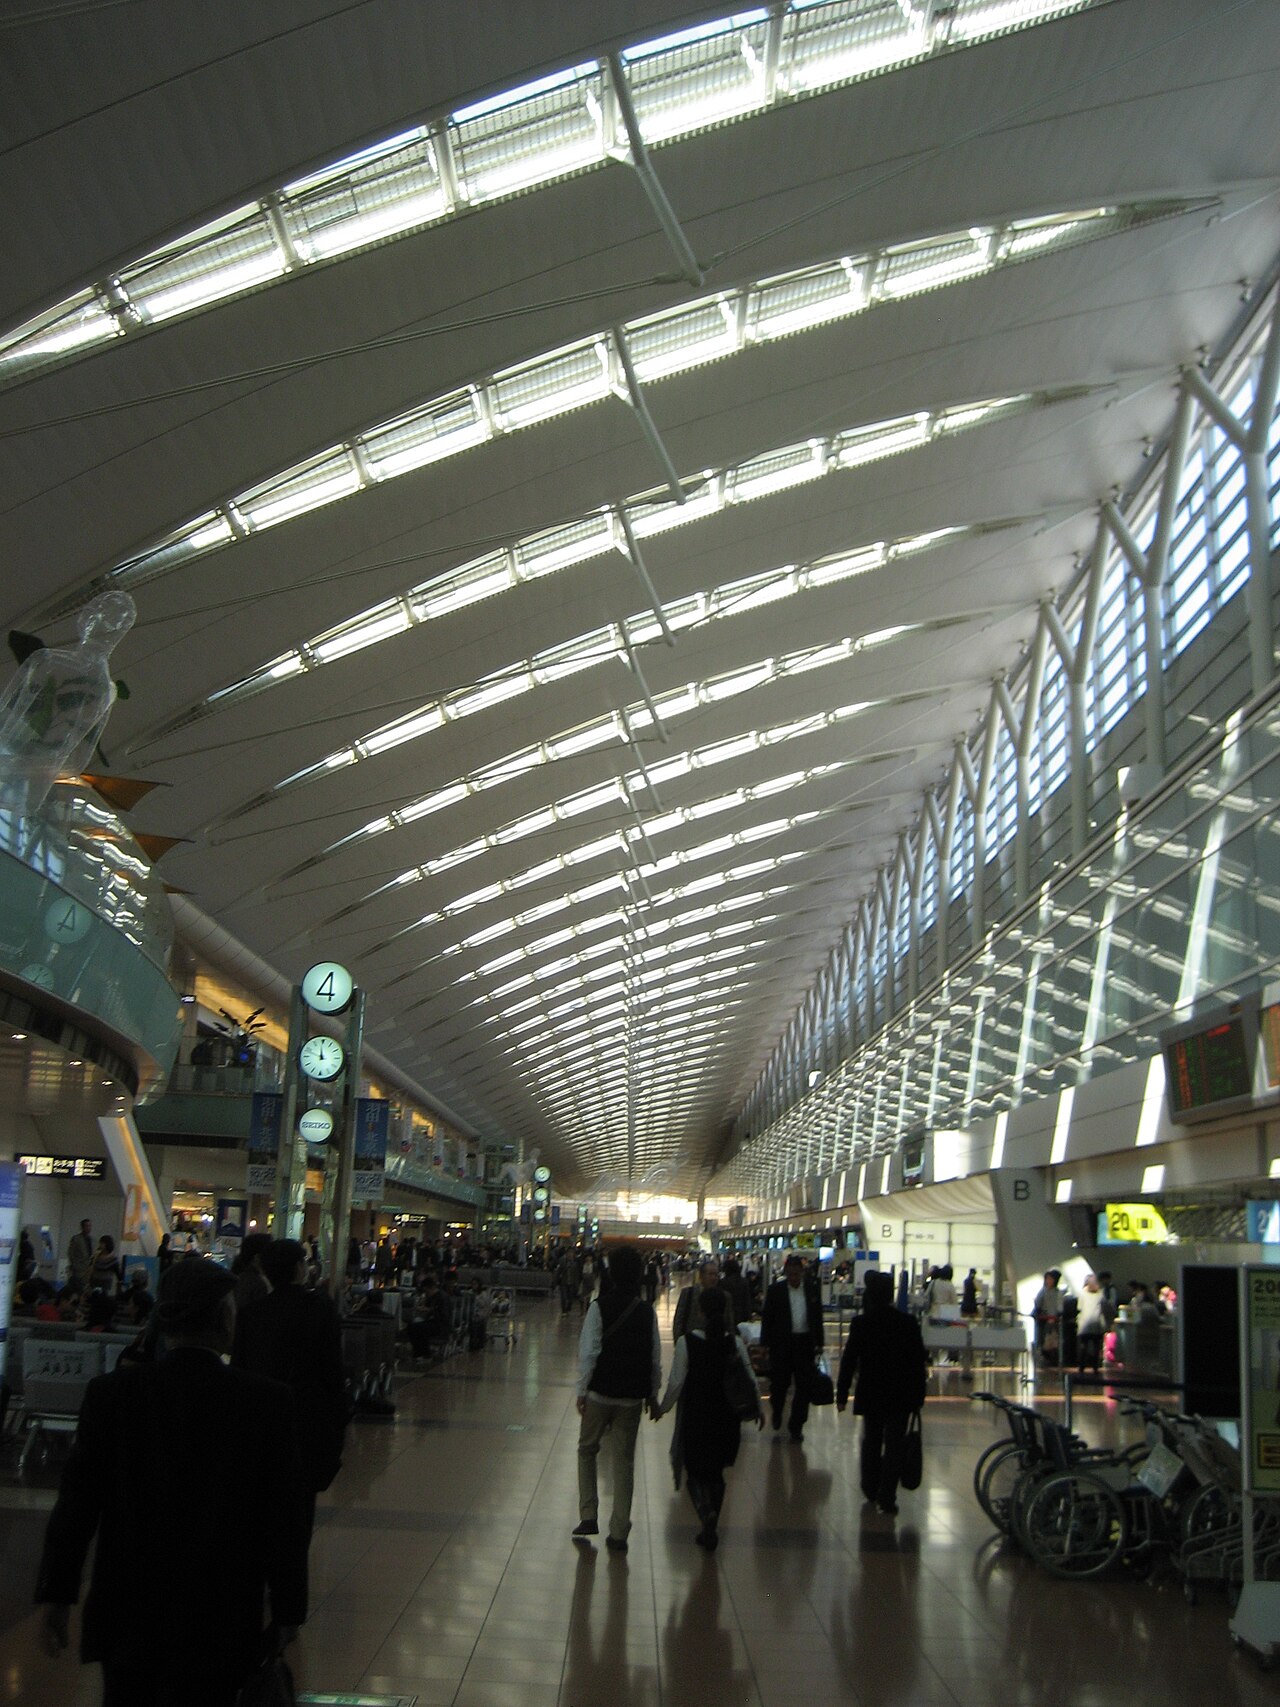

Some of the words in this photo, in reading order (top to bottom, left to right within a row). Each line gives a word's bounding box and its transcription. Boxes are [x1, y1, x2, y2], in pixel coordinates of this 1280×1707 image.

[316, 971, 335, 1002] 4
[301, 1121, 331, 1130] SEIKO
[1014, 1179, 1030, 1201] B
[1111, 1212, 1130, 1232] 20
[881, 1224, 892, 1238] B
[1254, 1279, 1280, 1294] 20
